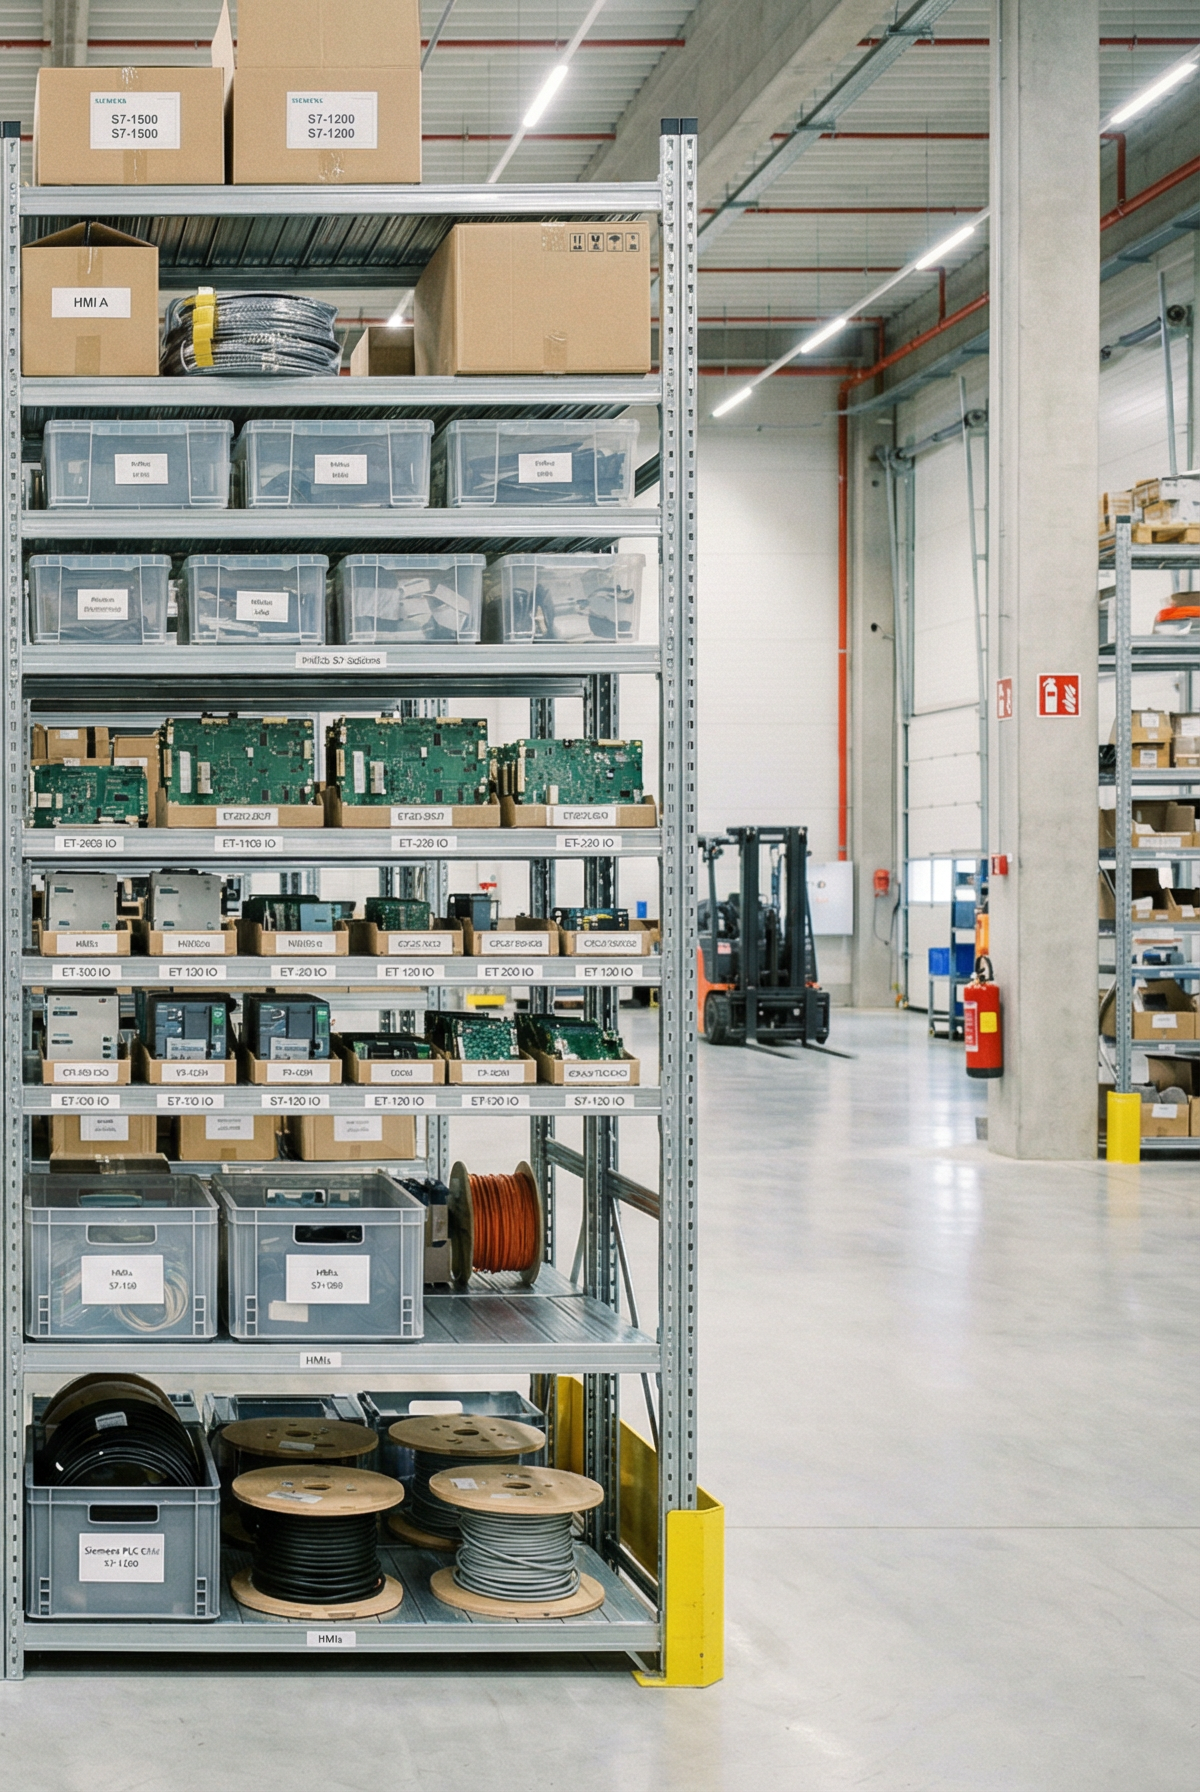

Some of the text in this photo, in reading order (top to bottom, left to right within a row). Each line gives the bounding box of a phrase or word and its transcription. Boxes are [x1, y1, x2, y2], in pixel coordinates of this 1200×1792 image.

[111, 114, 158, 125] S7-1500
[308, 114, 355, 124] S7-1200
[112, 128, 158, 139] S7-1500
[308, 128, 355, 139] S7-1200
[74, 297, 108, 308] HMI A
[105, 838, 117, 848] IO
[264, 838, 276, 848] IO
[436, 838, 448, 848] IO
[602, 838, 614, 848] IO
[98, 967, 111, 978] IO
[206, 967, 218, 977] IO
[314, 967, 328, 977] IO
[385, 967, 400, 977] ET
[422, 967, 435, 977] IO
[484, 967, 499, 977] ET
[522, 967, 534, 977] IO
[621, 967, 634, 977] IO
[97, 1096, 110, 1106] IO
[201, 1096, 214, 1106] IO
[308, 1096, 321, 1106] IO
[412, 1096, 425, 1106] IO
[506, 1096, 519, 1106] IO
[612, 1096, 625, 1106] IO
[122, 1547, 139, 1556] PLC
